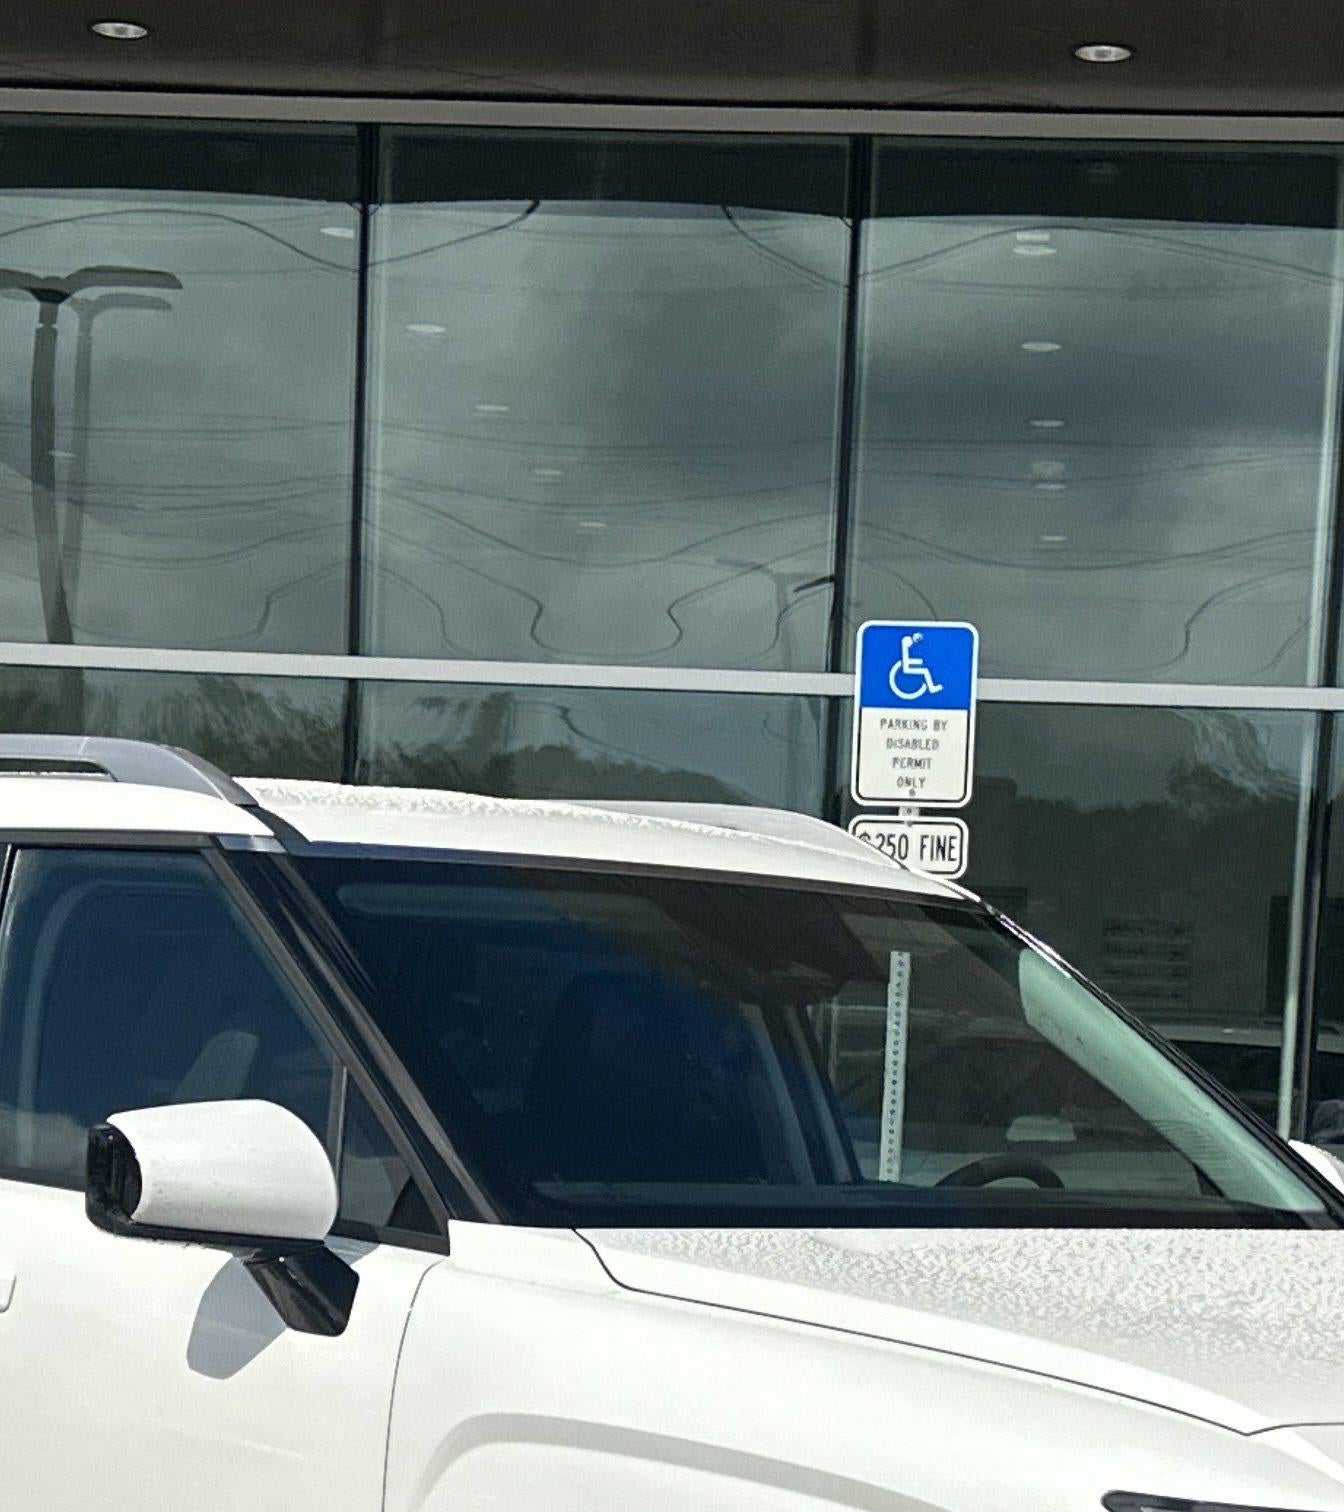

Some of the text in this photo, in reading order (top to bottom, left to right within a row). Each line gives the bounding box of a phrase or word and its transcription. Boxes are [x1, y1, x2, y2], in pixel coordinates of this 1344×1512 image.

[880, 717, 949, 731] PARKING BY
[886, 738, 940, 751] DISABLED
[892, 757, 932, 769] PERMIT
[896, 776, 926, 789] ONLY
[919, 834, 957, 862] FINE
